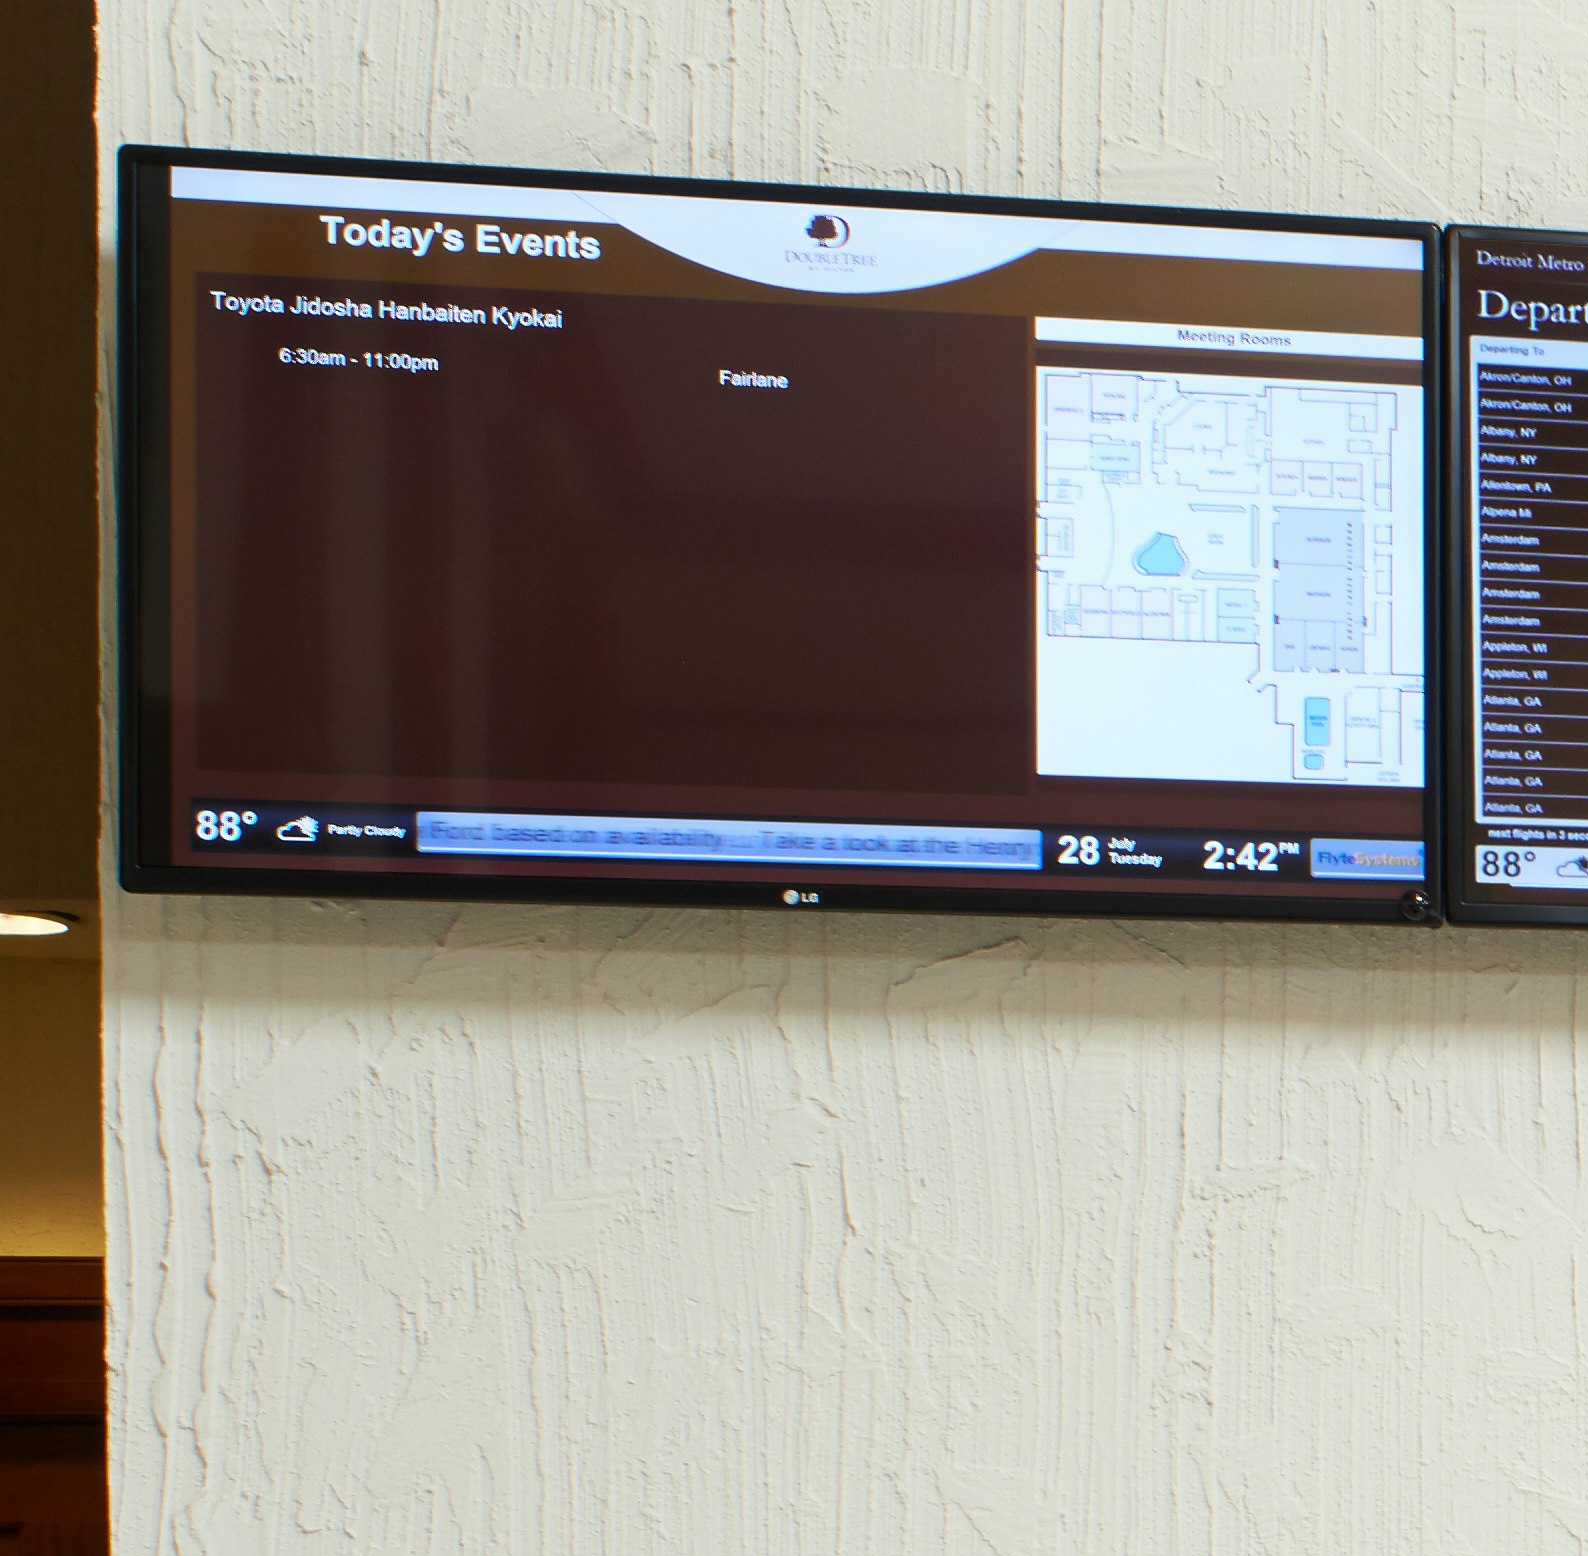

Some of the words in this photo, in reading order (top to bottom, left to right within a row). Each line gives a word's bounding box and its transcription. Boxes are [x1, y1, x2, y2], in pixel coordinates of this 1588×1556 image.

[319, 214, 465, 257] Today's
[475, 224, 600, 260] Events
[1477, 250, 1532, 269] Detroit
[1538, 254, 1584, 272] Metro
[210, 291, 285, 316] Toyota
[290, 295, 372, 319] Jidosha
[379, 300, 486, 326] Hanbaiten
[492, 305, 563, 330] Kyokai
[1178, 329, 1235, 347] Meeting
[1240, 333, 1291, 347] Rooms
[279, 347, 346, 368] 6:30am
[364, 351, 439, 372] 11:00pm
[1480, 344, 1529, 356] Departing
[1532, 346, 1544, 356] To
[719, 370, 789, 388] Fairlane
[196, 810, 258, 842] 88°
[327, 824, 362, 837] Partly
[364, 826, 405, 840] Cloudy
[1058, 835, 1099, 865] 28
[1108, 837, 1135, 851] July
[1108, 852, 1162, 868] Tuesday
[1203, 840, 1278, 871] 2:42
[1279, 842, 1299, 855] PM
[801, 893, 819, 903] LG
